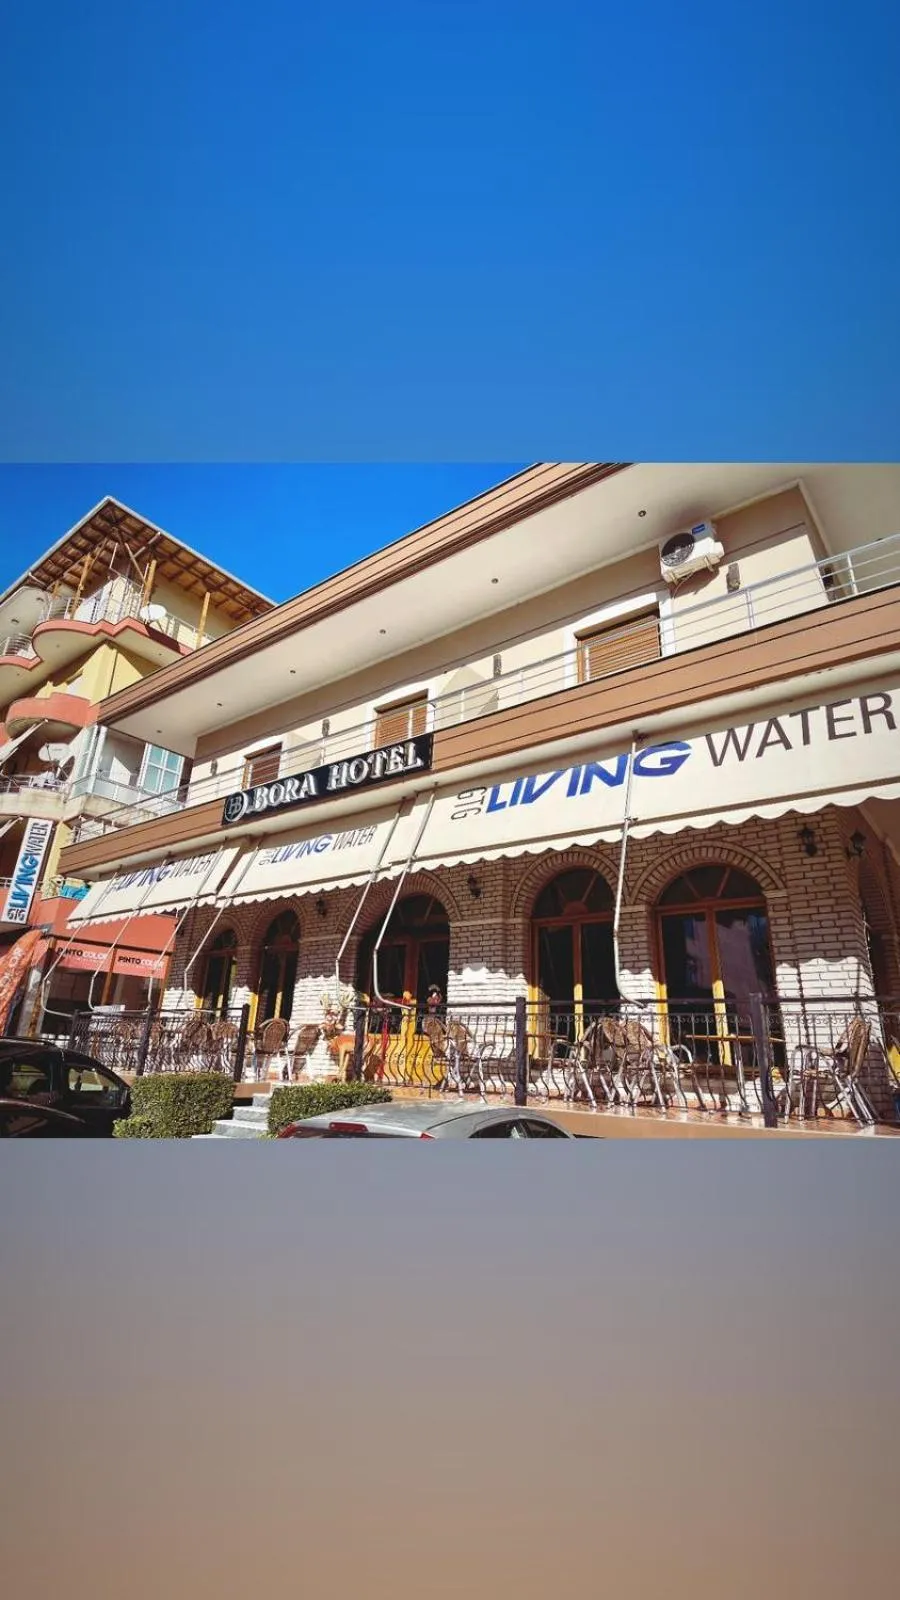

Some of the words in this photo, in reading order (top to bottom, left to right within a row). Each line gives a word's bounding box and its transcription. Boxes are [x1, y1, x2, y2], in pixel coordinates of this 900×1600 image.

[246, 771, 318, 814] BORA
[327, 741, 424, 791] HOTEL
[486, 740, 692, 814] LIVING
[705, 692, 897, 767] WATER
[9, 853, 39, 909] LIVING
[25, 822, 49, 856] WATER
[271, 832, 333, 864] LIVING
[331, 825, 377, 851] WATER
